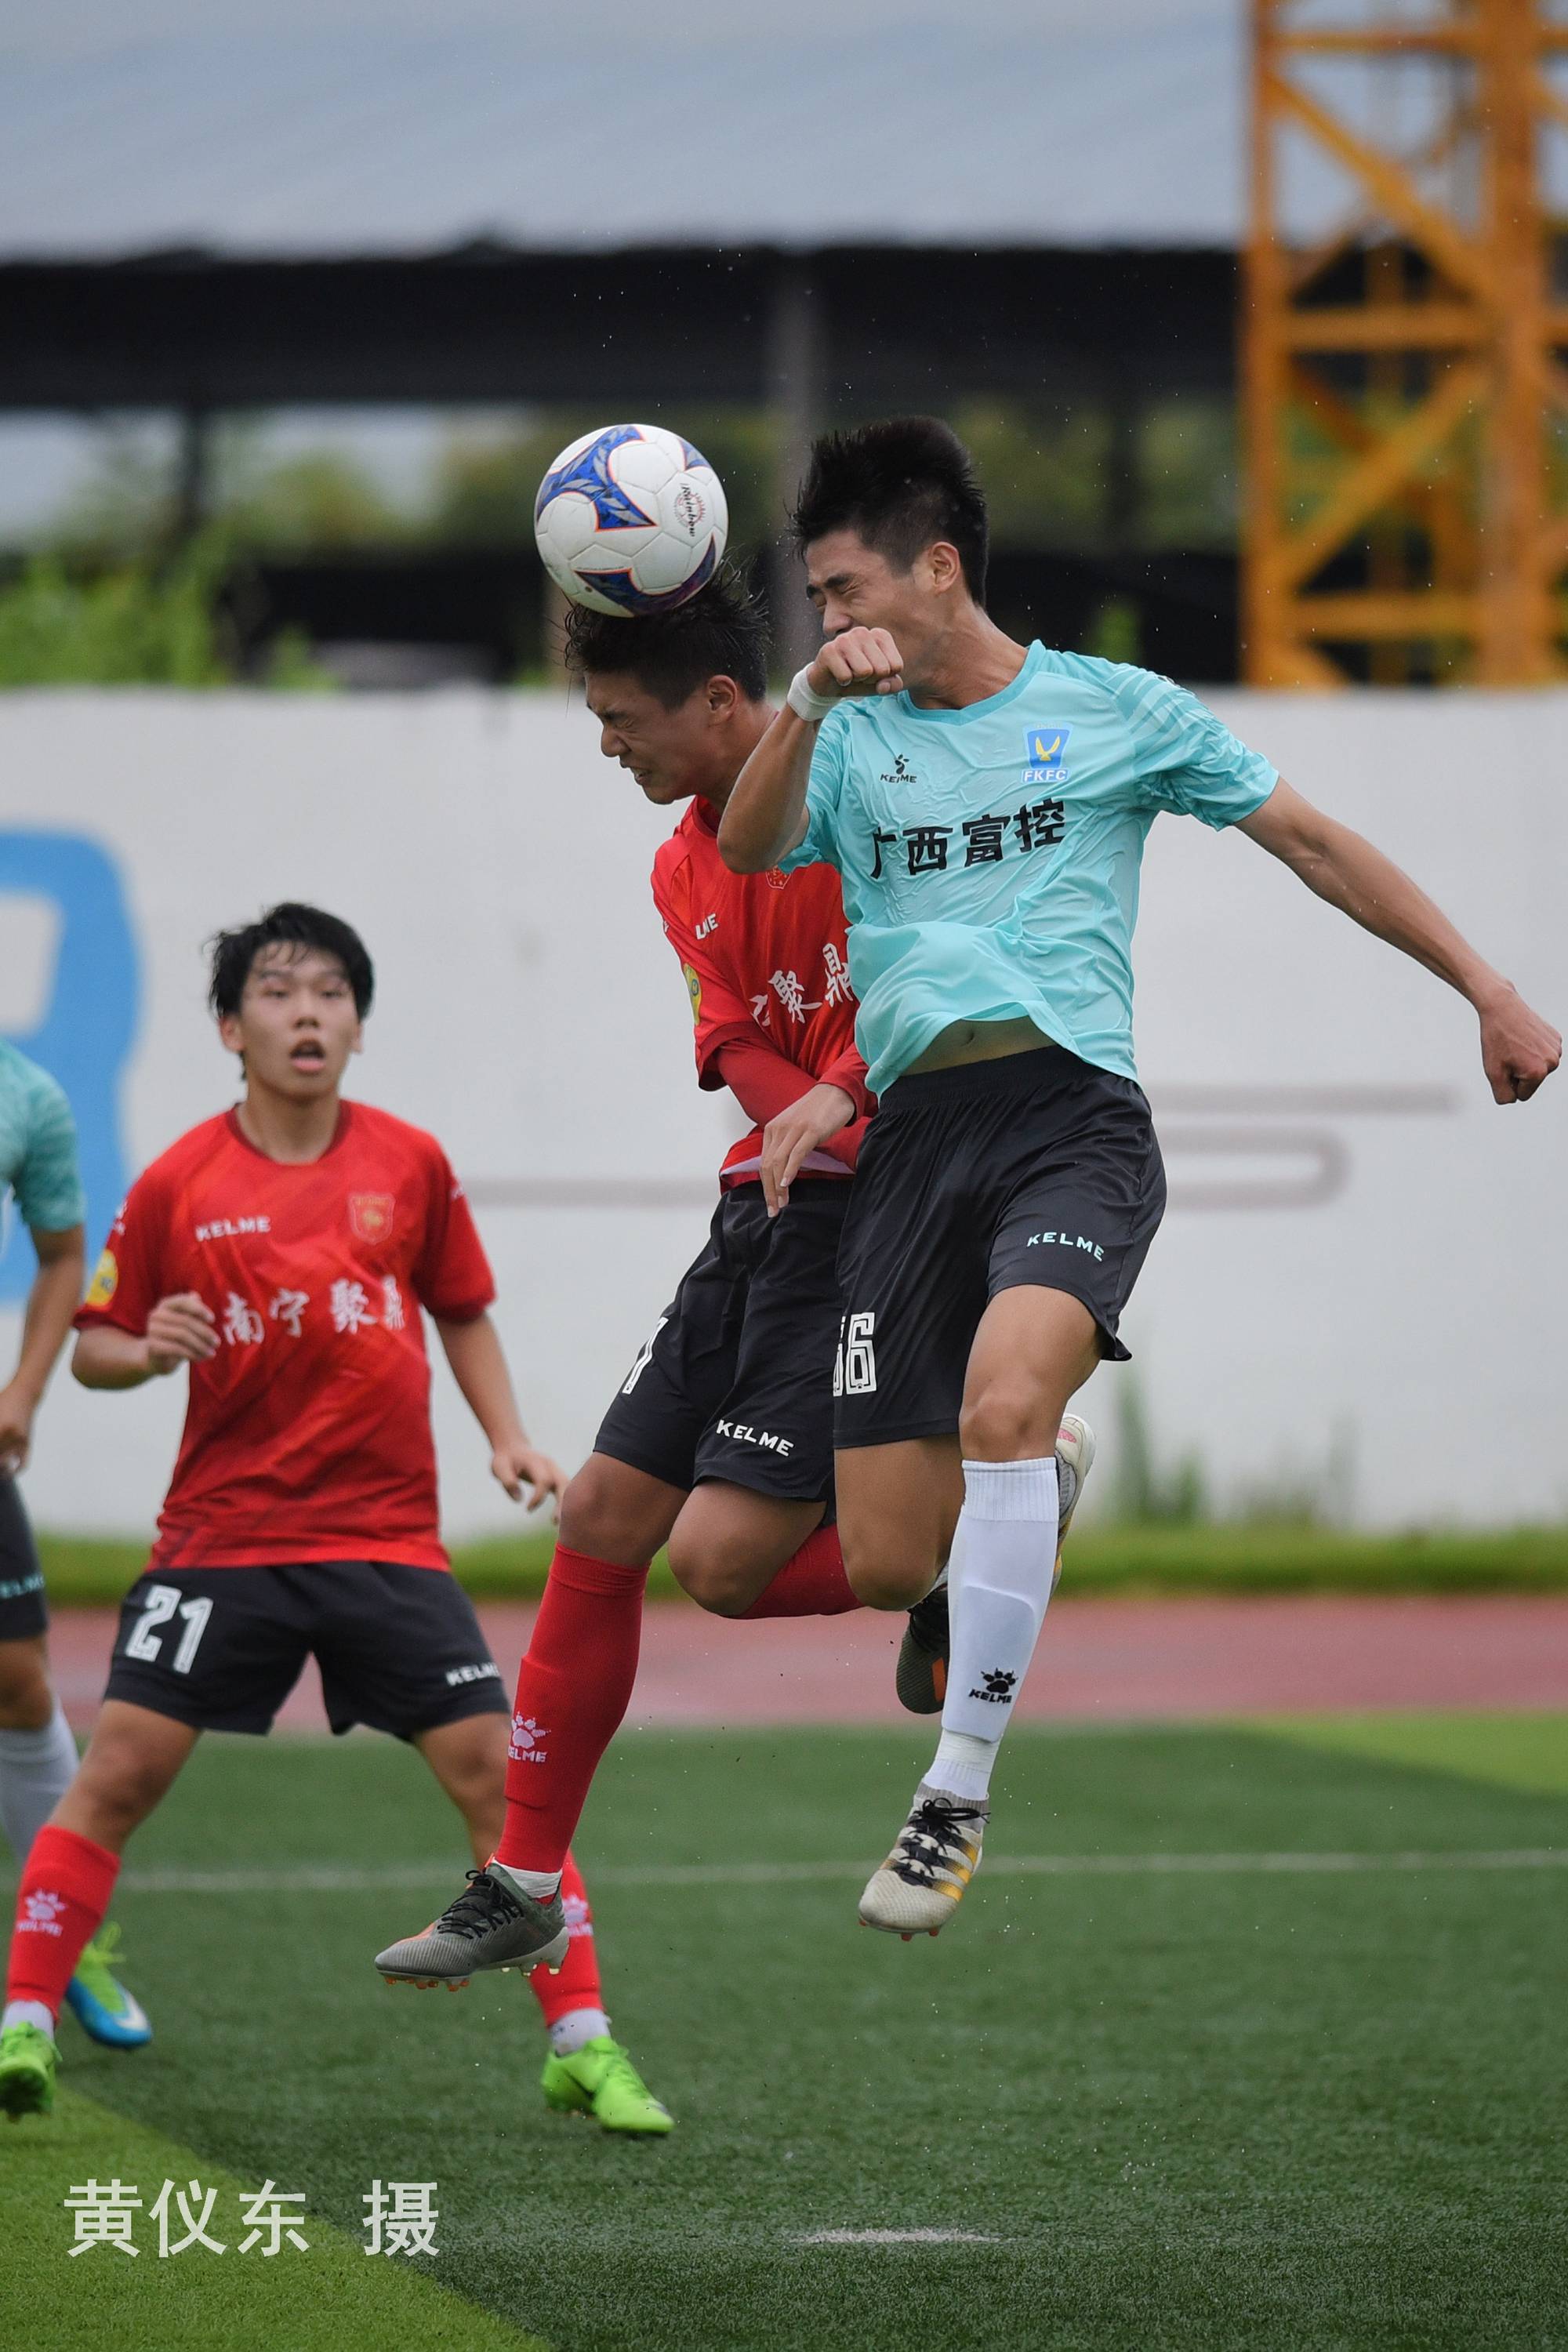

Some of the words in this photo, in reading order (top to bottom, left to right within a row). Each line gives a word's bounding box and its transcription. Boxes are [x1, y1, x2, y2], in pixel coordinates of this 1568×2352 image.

[1024, 769, 1067, 782] FKFC
[870, 797, 1065, 880] 广西富控
[194, 1216, 270, 1241] KELME
[1026, 1232, 1105, 1261] KELME
[716, 1420, 794, 1457] KELME
[125, 1584, 213, 1675] 21
[968, 1689, 1012, 1704] KELME
